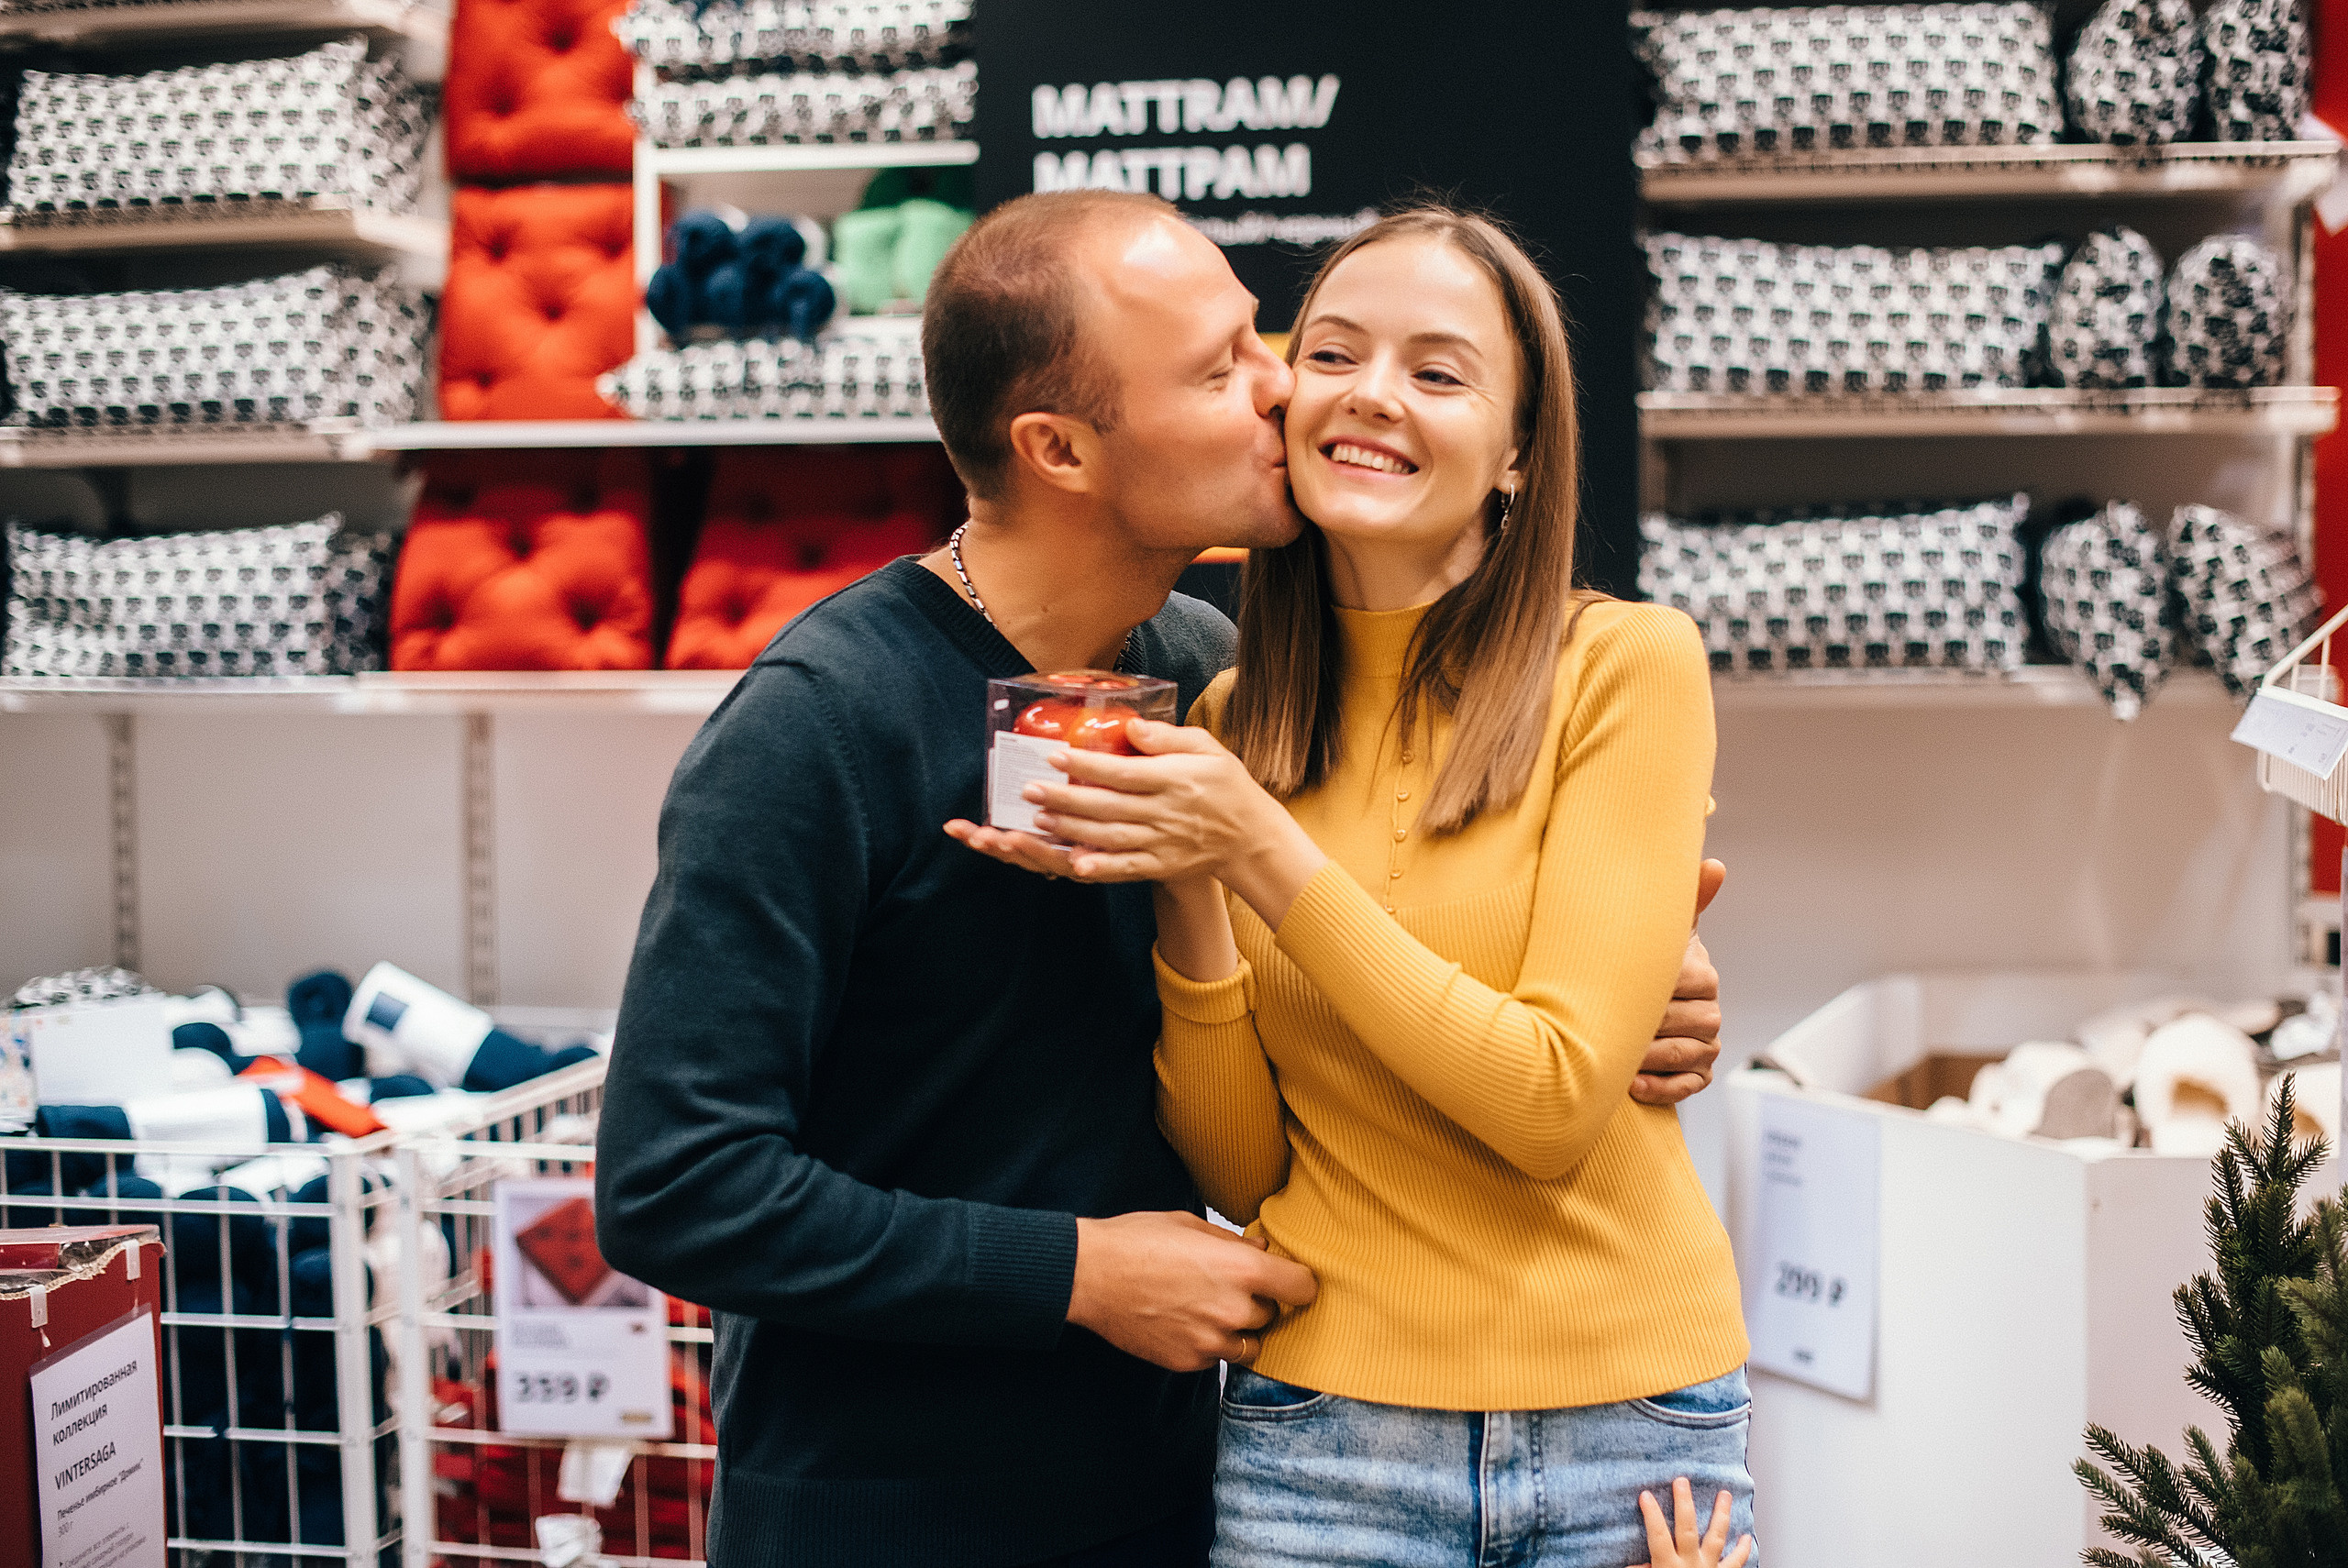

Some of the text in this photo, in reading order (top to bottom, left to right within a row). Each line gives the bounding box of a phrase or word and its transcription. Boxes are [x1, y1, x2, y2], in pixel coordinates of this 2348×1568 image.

[51, 1360, 138, 1420] Лимитированная
[52, 1403, 108, 1446] коллекция
[54, 1441, 116, 1490] VINTERSAGA
[57, 1497, 85, 1521] Печенье
